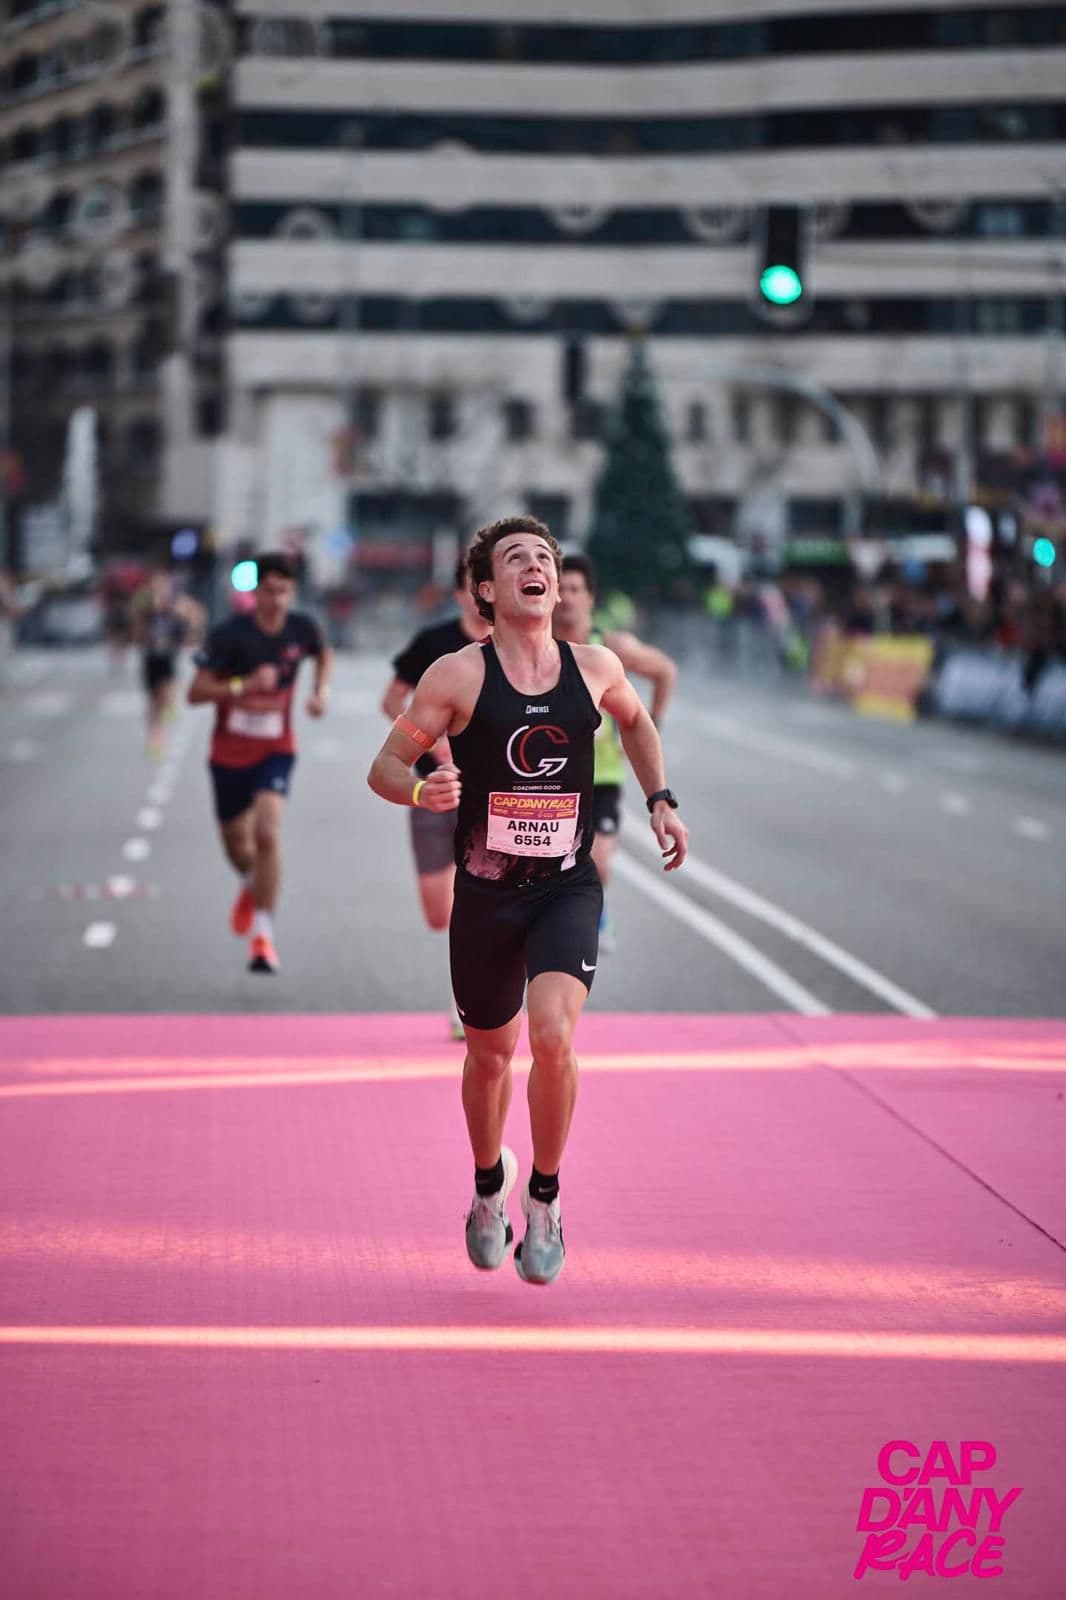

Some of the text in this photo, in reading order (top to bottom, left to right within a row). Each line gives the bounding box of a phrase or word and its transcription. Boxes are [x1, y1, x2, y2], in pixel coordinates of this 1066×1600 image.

[493, 796, 517, 807] CAP
[507, 820, 560, 833] ARNAU
[514, 834, 552, 847] 6554
